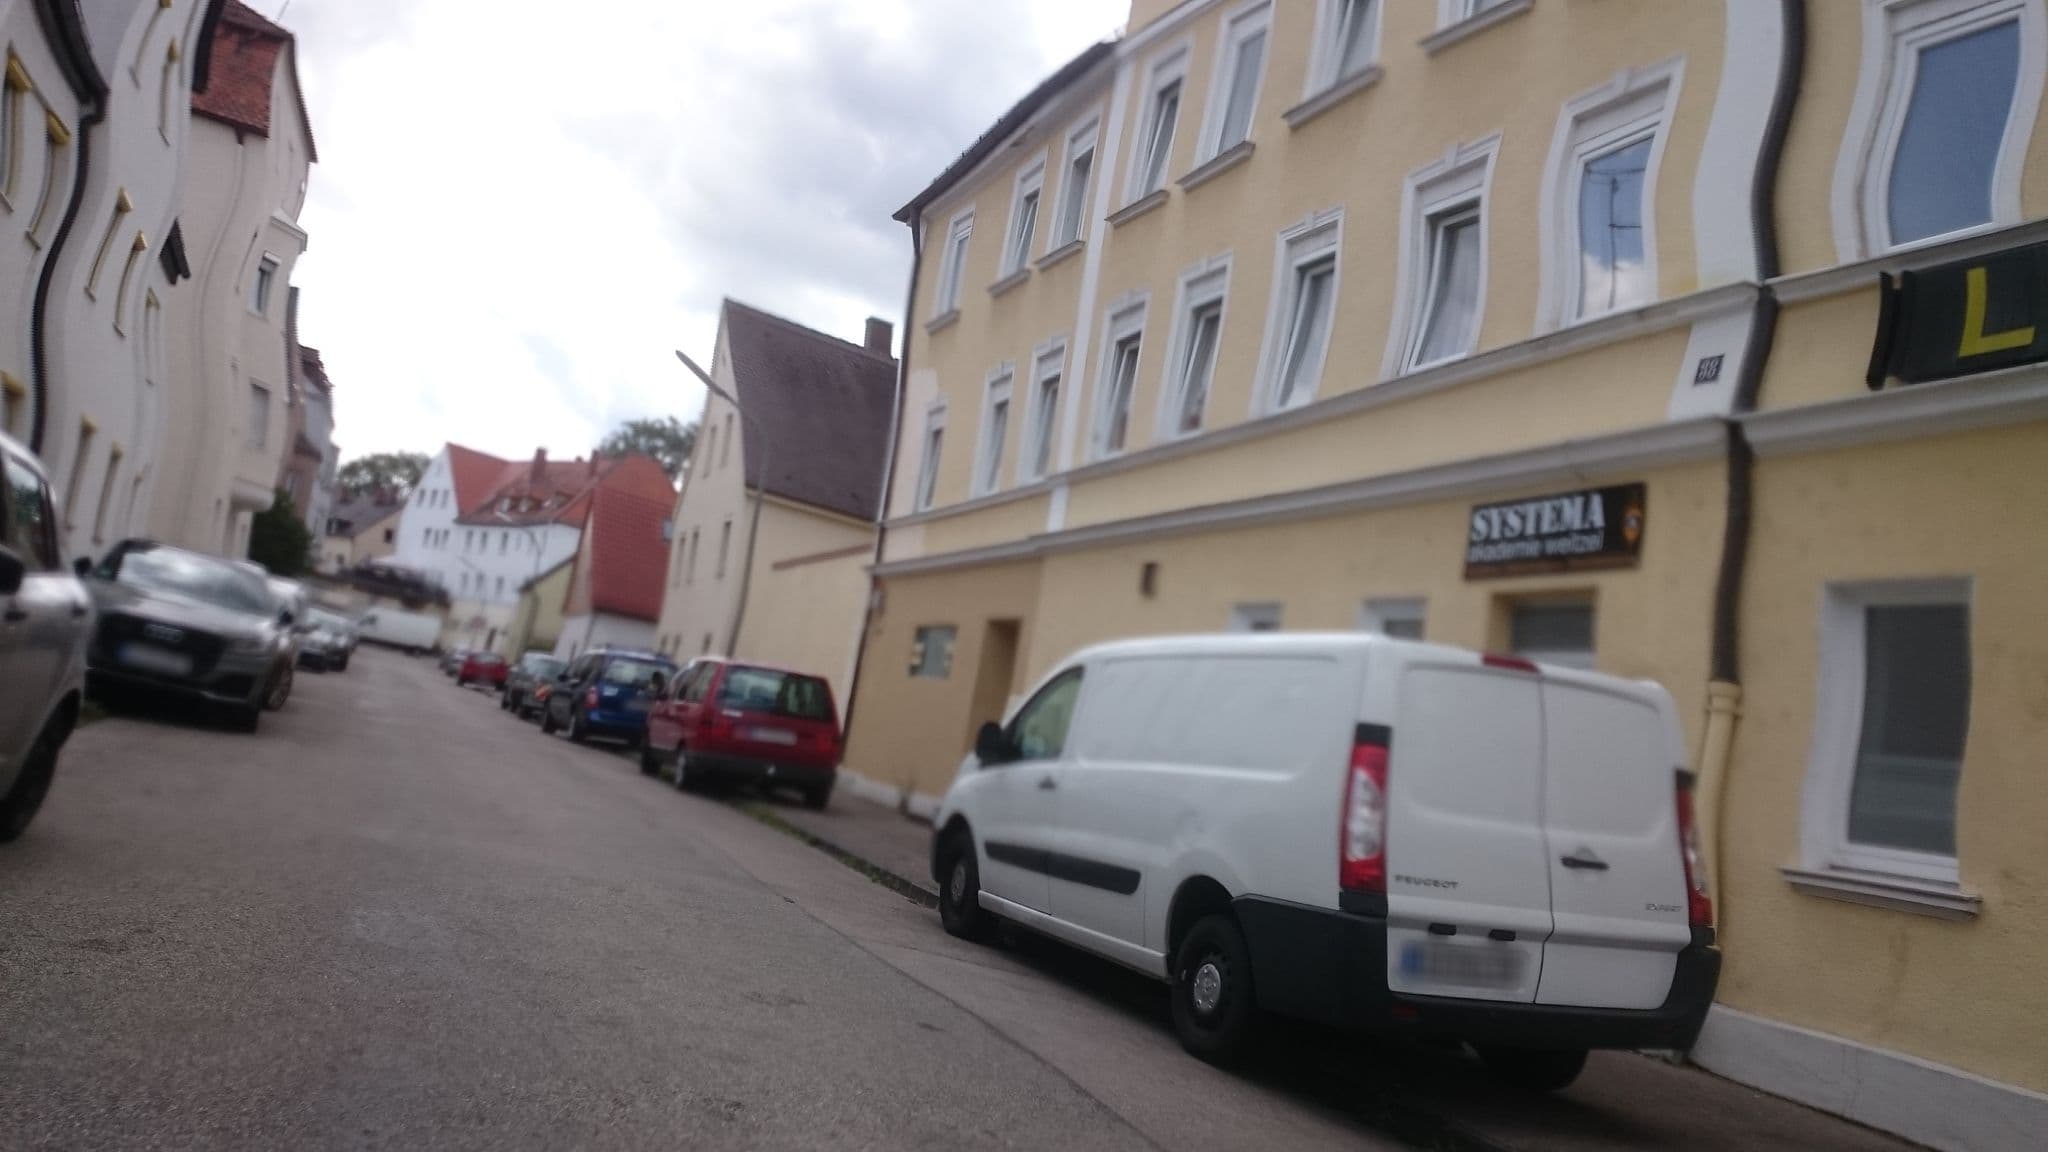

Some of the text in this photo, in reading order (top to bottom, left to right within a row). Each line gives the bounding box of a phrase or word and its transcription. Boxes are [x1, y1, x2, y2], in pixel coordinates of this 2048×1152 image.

[1958, 267, 2036, 358] L
[1471, 492, 1605, 541] SYSTEMA
[1394, 874, 1459, 888] PEUGEOT
